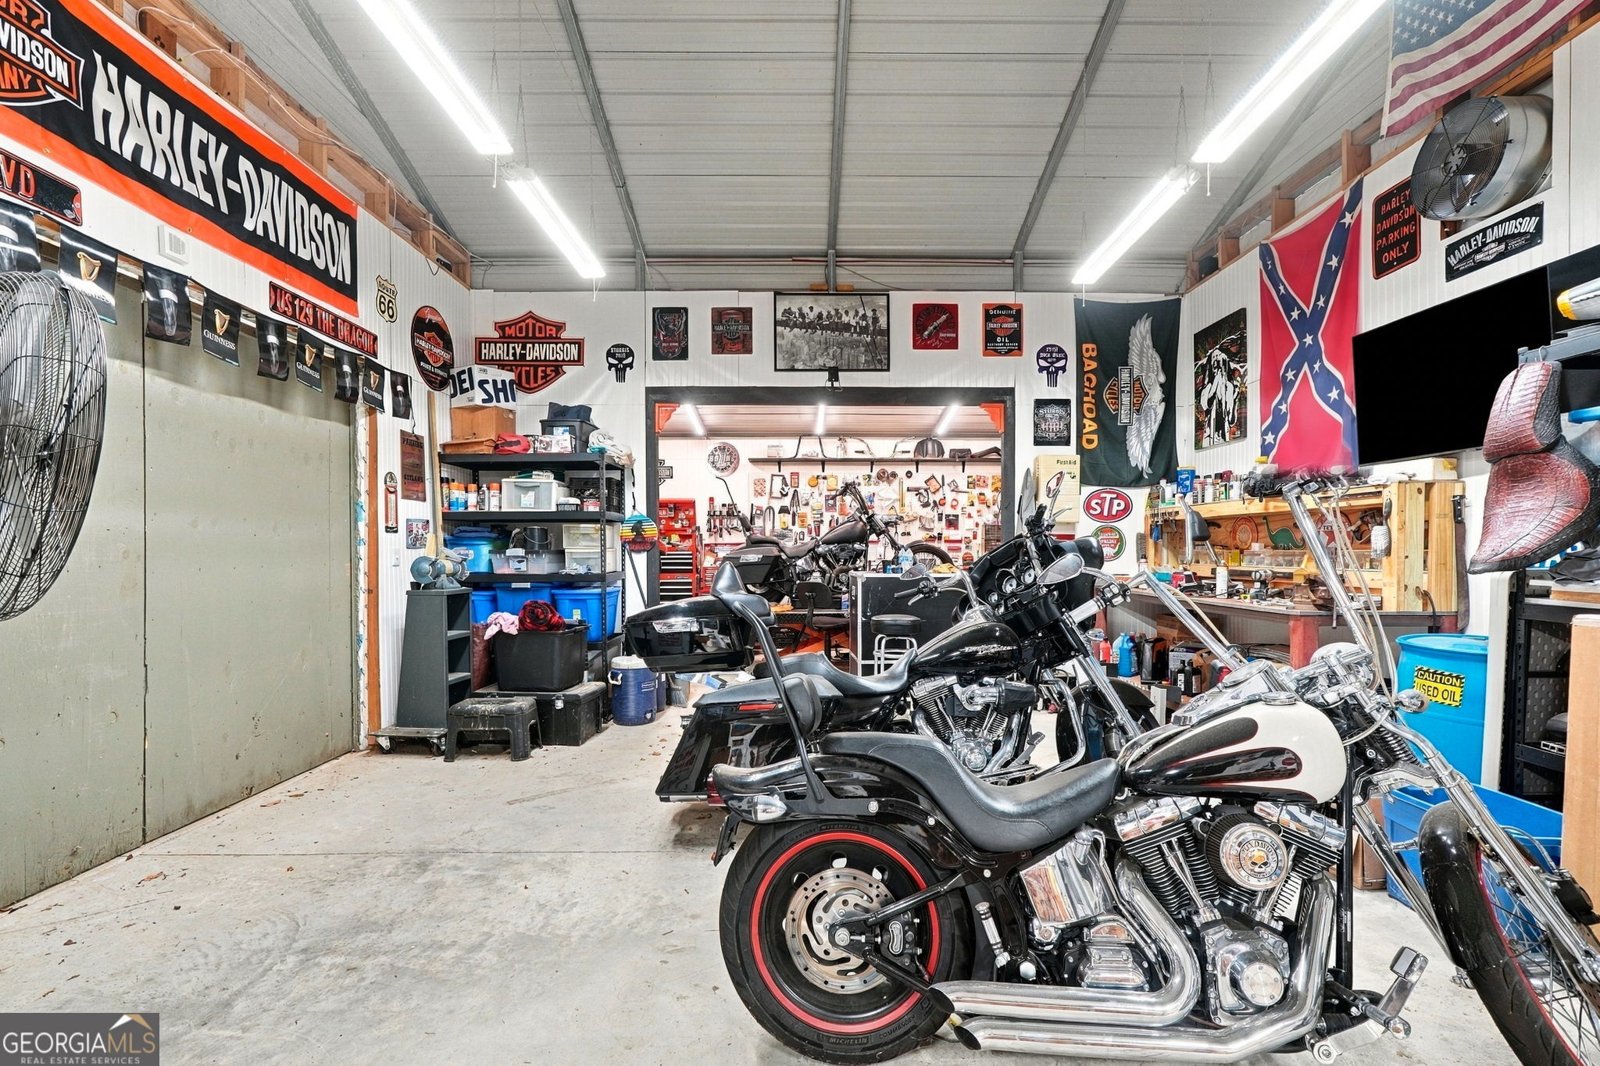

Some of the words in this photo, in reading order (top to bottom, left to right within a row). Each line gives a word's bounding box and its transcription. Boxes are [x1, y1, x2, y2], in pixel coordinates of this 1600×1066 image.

[92, 49, 350, 285] HARLEY-DAVIDSON
[1380, 189, 1411, 215] HARLEY
[1376, 205, 1416, 234] DAVIDSON
[1376, 221, 1416, 250] PARKING
[1447, 216, 1540, 267] HARLEY-DAVIDSON
[1382, 242, 1409, 264] ONLY
[378, 281, 396, 297] ROUTE
[378, 295, 395, 319] 66
[276, 288, 293, 317] US
[294, 298, 314, 326] 129
[316, 307, 335, 336] THE
[337, 320, 376, 354] DRAGON
[505, 320, 558, 338] MOTOR
[203, 329, 236, 350] GUINNESS
[481, 342, 579, 362] HARLEY-DAVIDSON
[505, 366, 557, 388] YCLES
[1082, 343, 1099, 450] BAGHDAD
[1089, 493, 1126, 516] STP
[1417, 670, 1461, 687] CAUTION
[1416, 682, 1438, 698] USED
[1441, 688, 1458, 703] OIL
